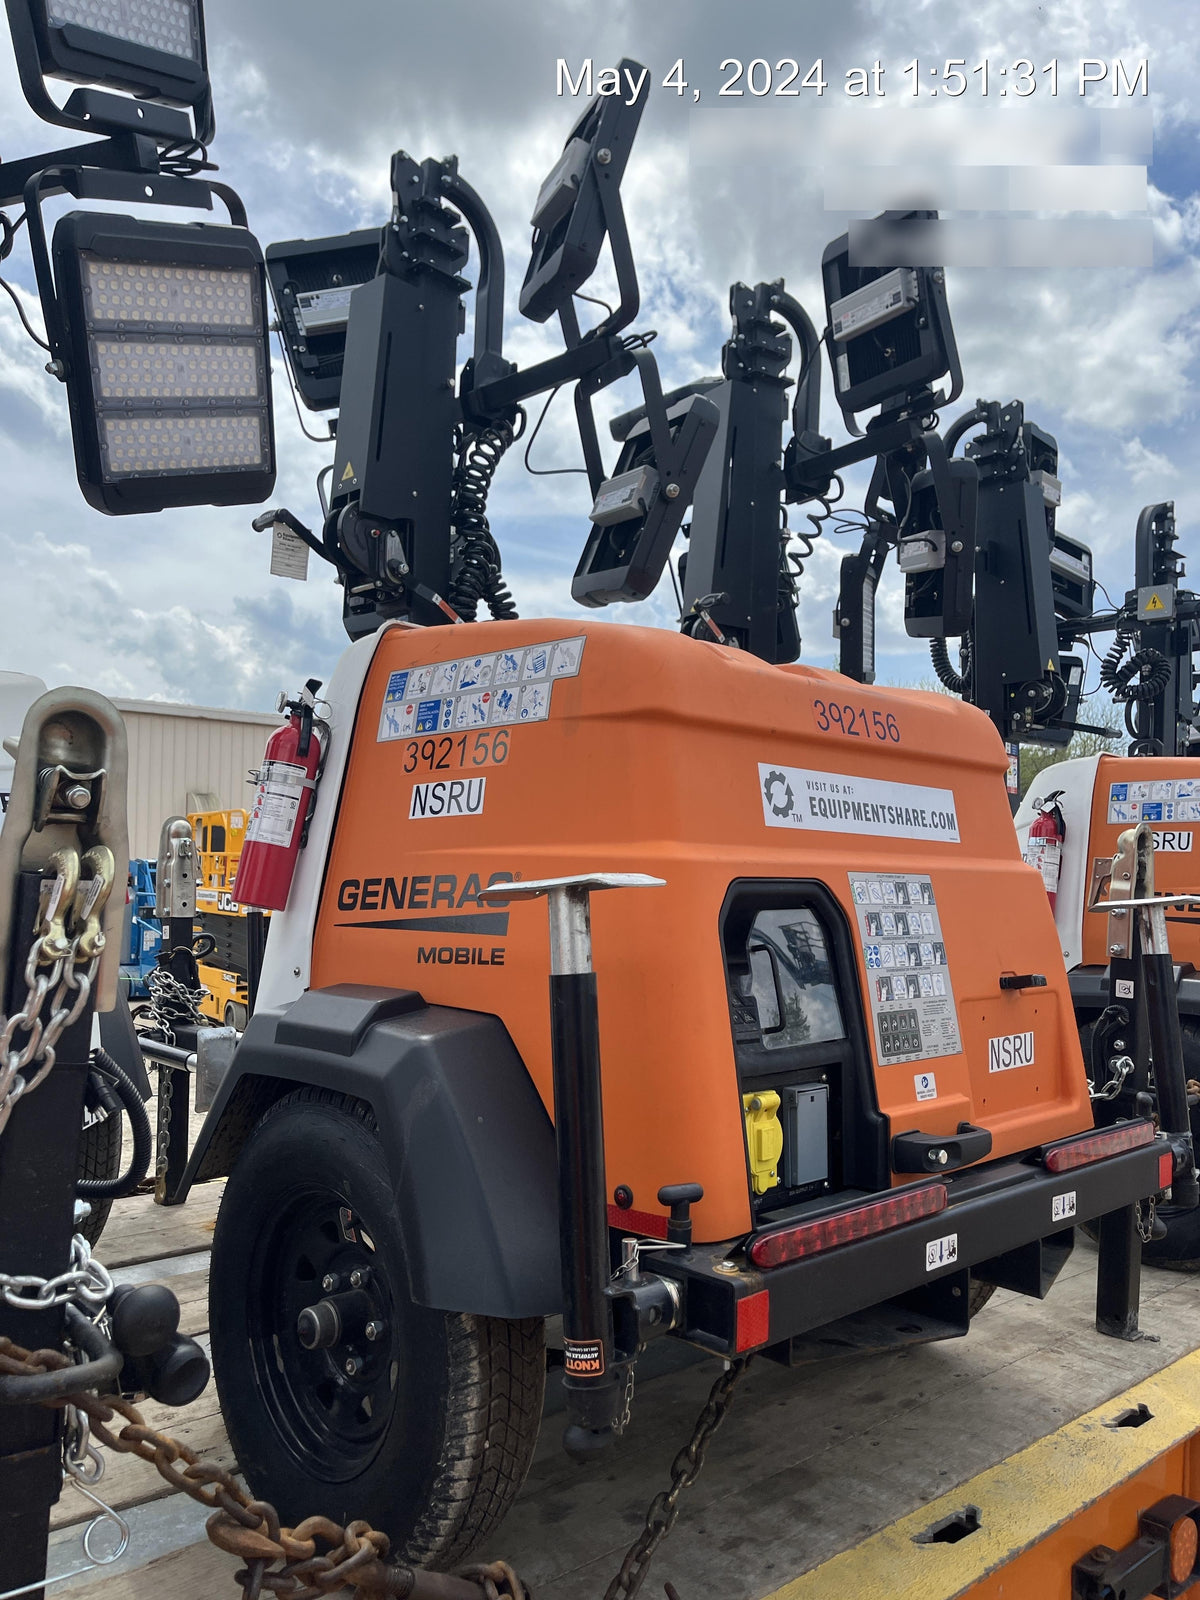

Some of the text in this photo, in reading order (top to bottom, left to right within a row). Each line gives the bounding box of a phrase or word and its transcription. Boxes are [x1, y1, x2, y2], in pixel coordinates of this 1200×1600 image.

[813, 699, 900, 743] 392156
[403, 729, 510, 774] 392156
[411, 778, 484, 817] NSRU
[805, 780, 855, 795] VISIT US AT:
[791, 813, 803, 823] TM
[808, 796, 957, 831] EQUIPMENTSHARE.COM
[1152, 832, 1191, 851] SRU
[417, 946, 506, 966] MOBILE
[990, 1032, 1033, 1071] NSRU
[566, 1358, 600, 1370] KNOTT
